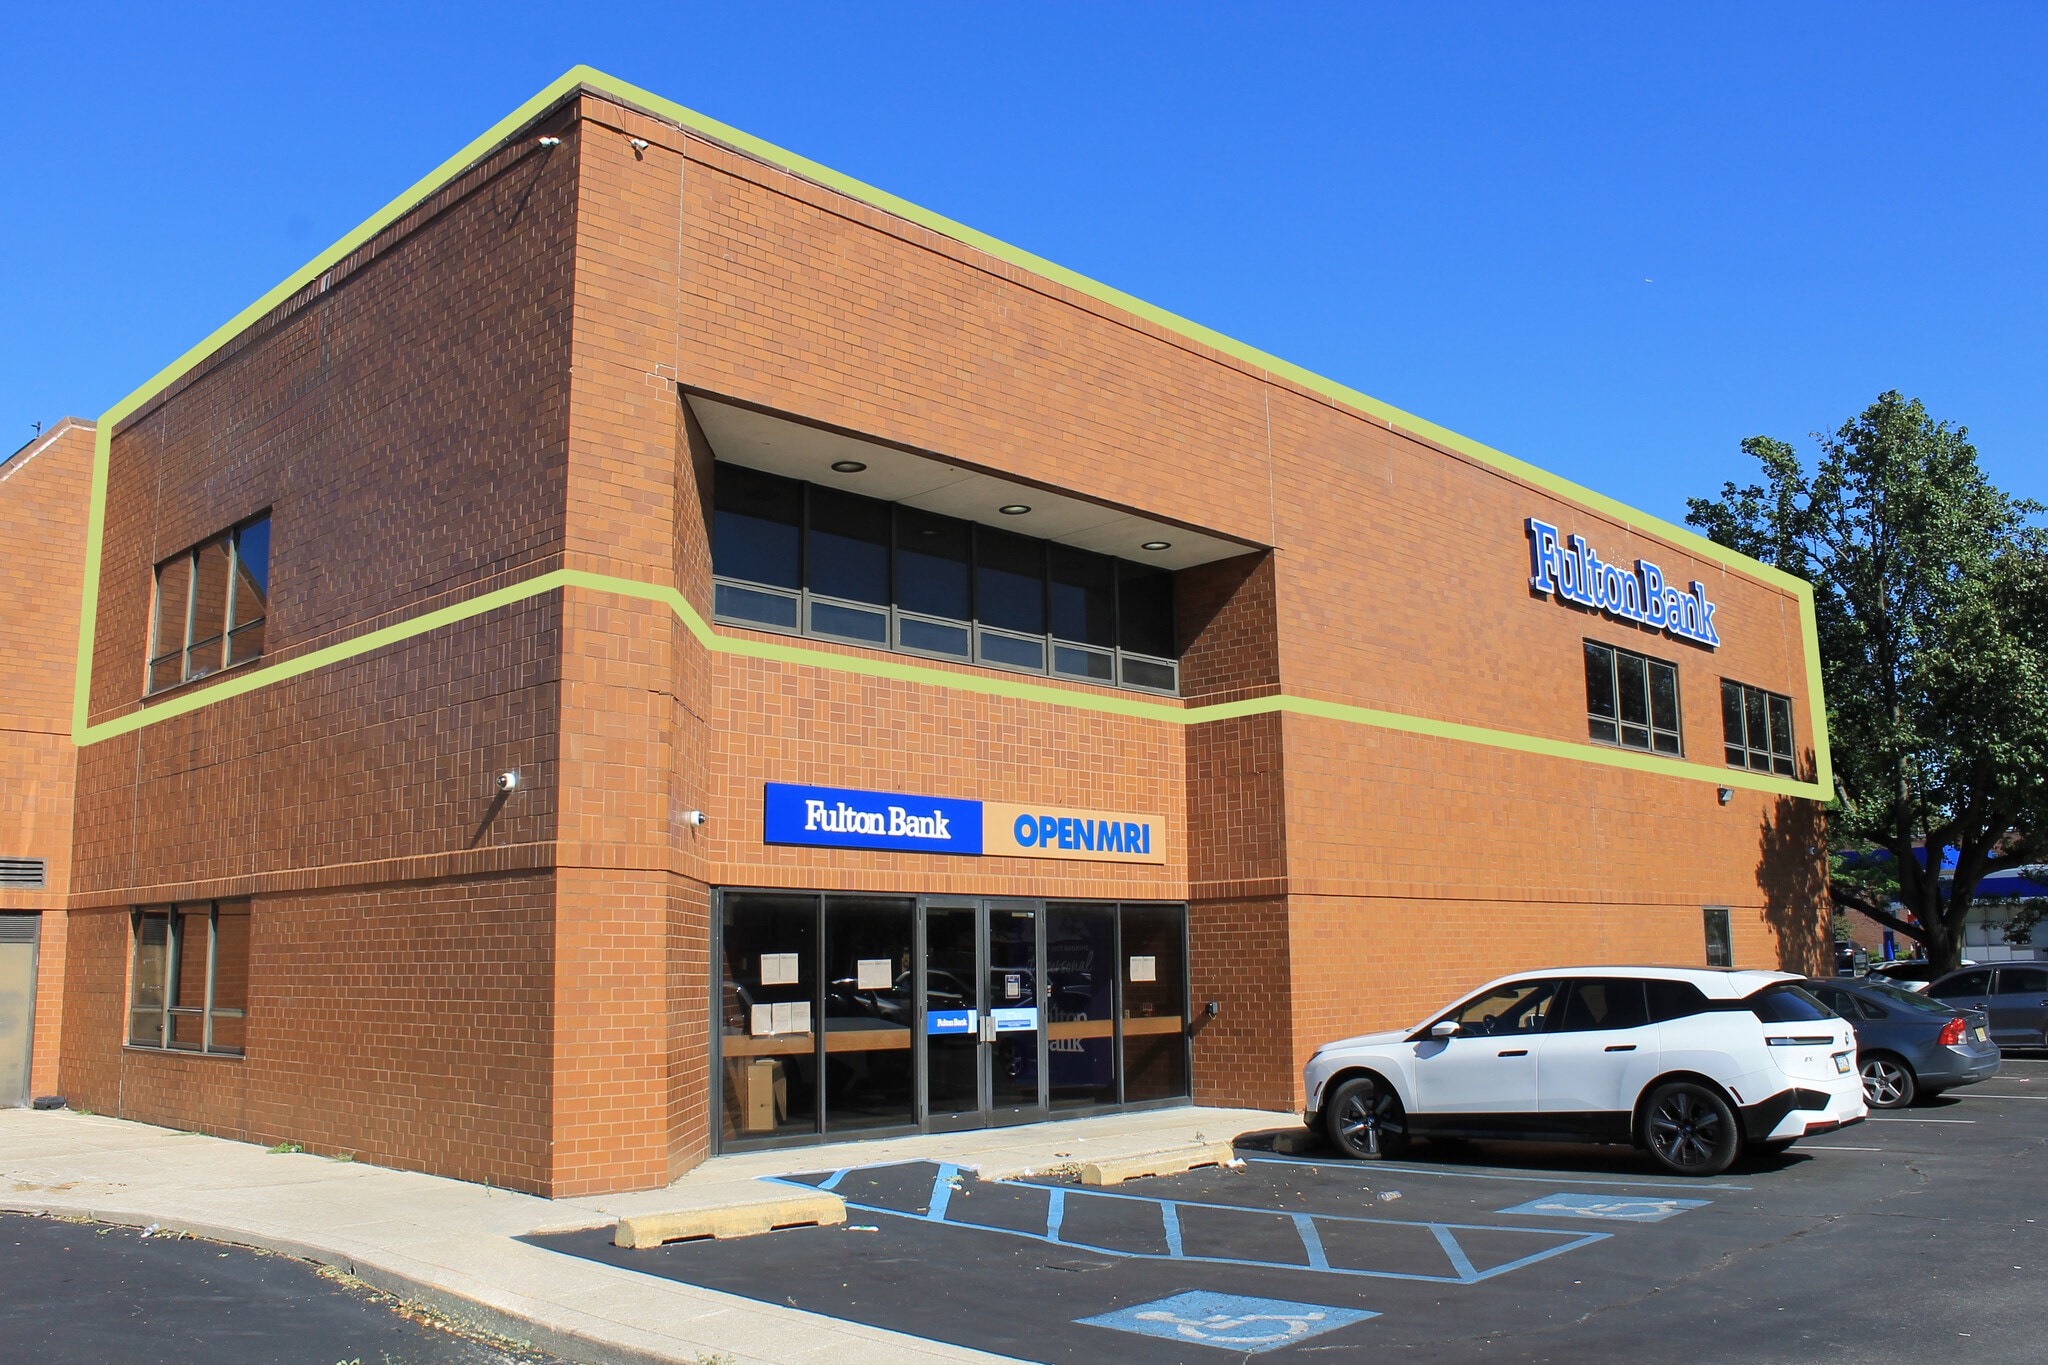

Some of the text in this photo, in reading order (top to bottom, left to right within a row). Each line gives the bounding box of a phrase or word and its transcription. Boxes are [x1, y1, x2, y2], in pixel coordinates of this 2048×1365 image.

[1530, 517, 1721, 647] Fulton Bank
[804, 799, 952, 840] Fulton Bank
[1013, 813, 1150, 855] OPEN MRI
[1048, 1038, 1086, 1053] ank
